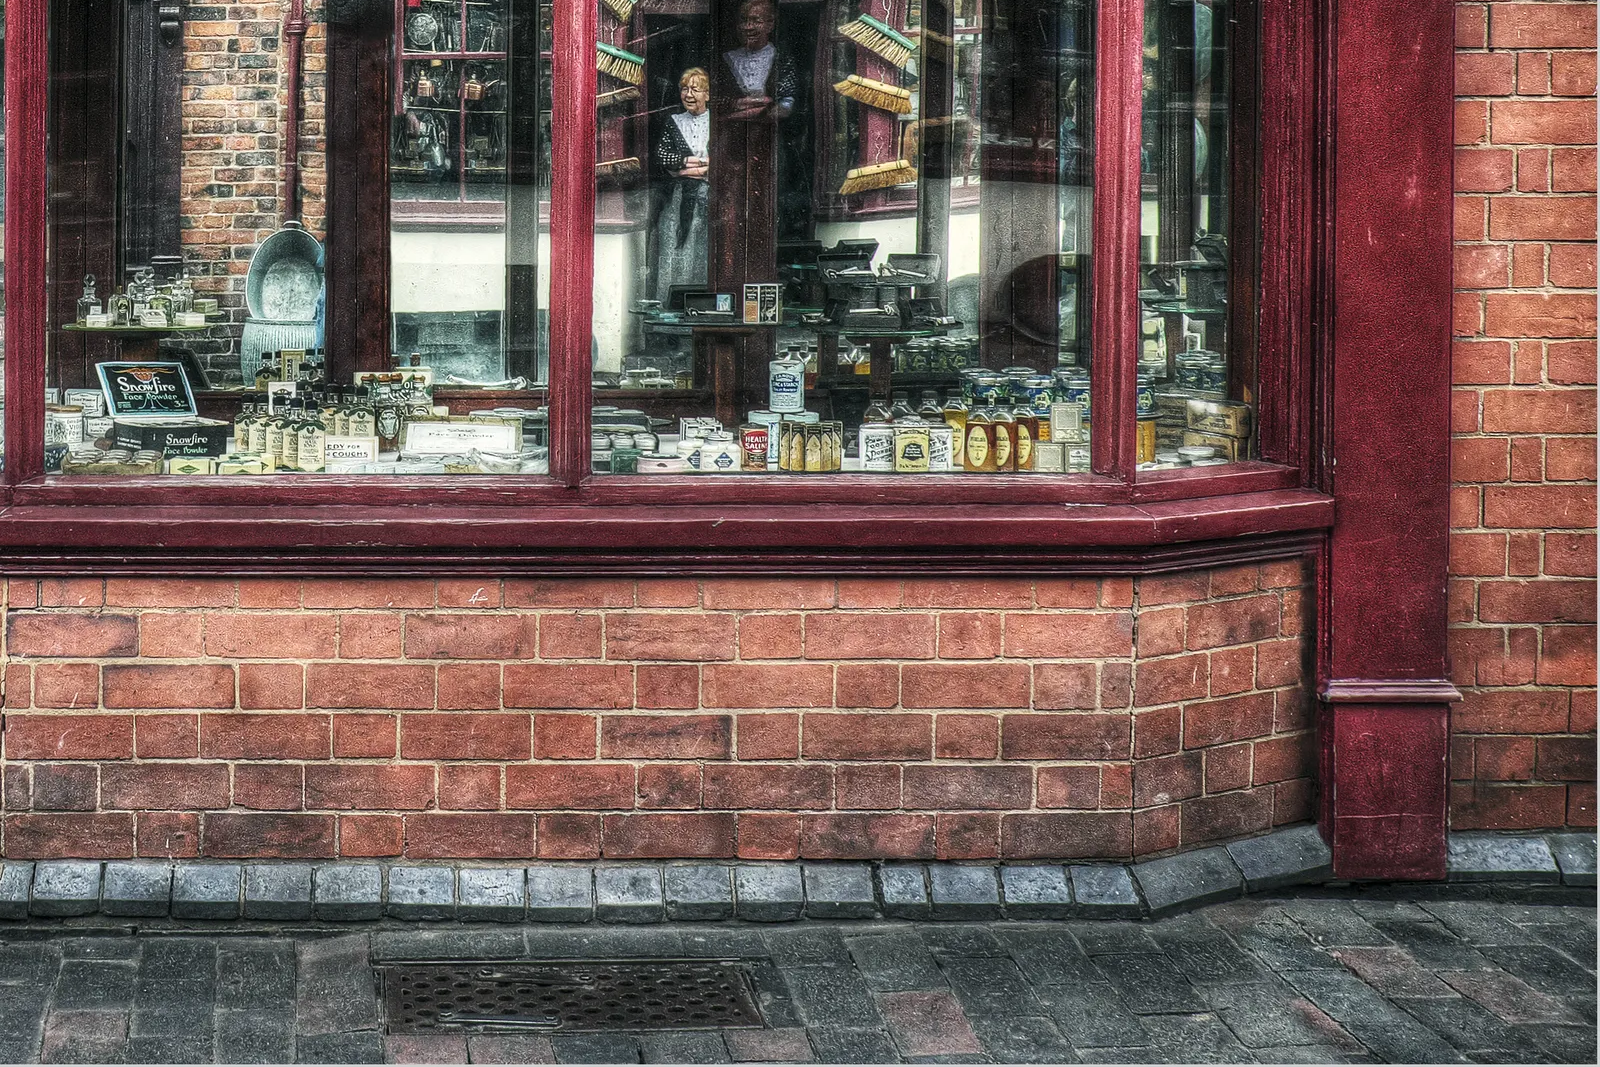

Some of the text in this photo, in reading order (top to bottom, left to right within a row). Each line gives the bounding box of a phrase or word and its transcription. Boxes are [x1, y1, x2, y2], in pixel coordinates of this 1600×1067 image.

[117, 376, 176, 394] Snowfire
[165, 433, 208, 446] Snowfire
[164, 445, 208, 454] Face Powder
